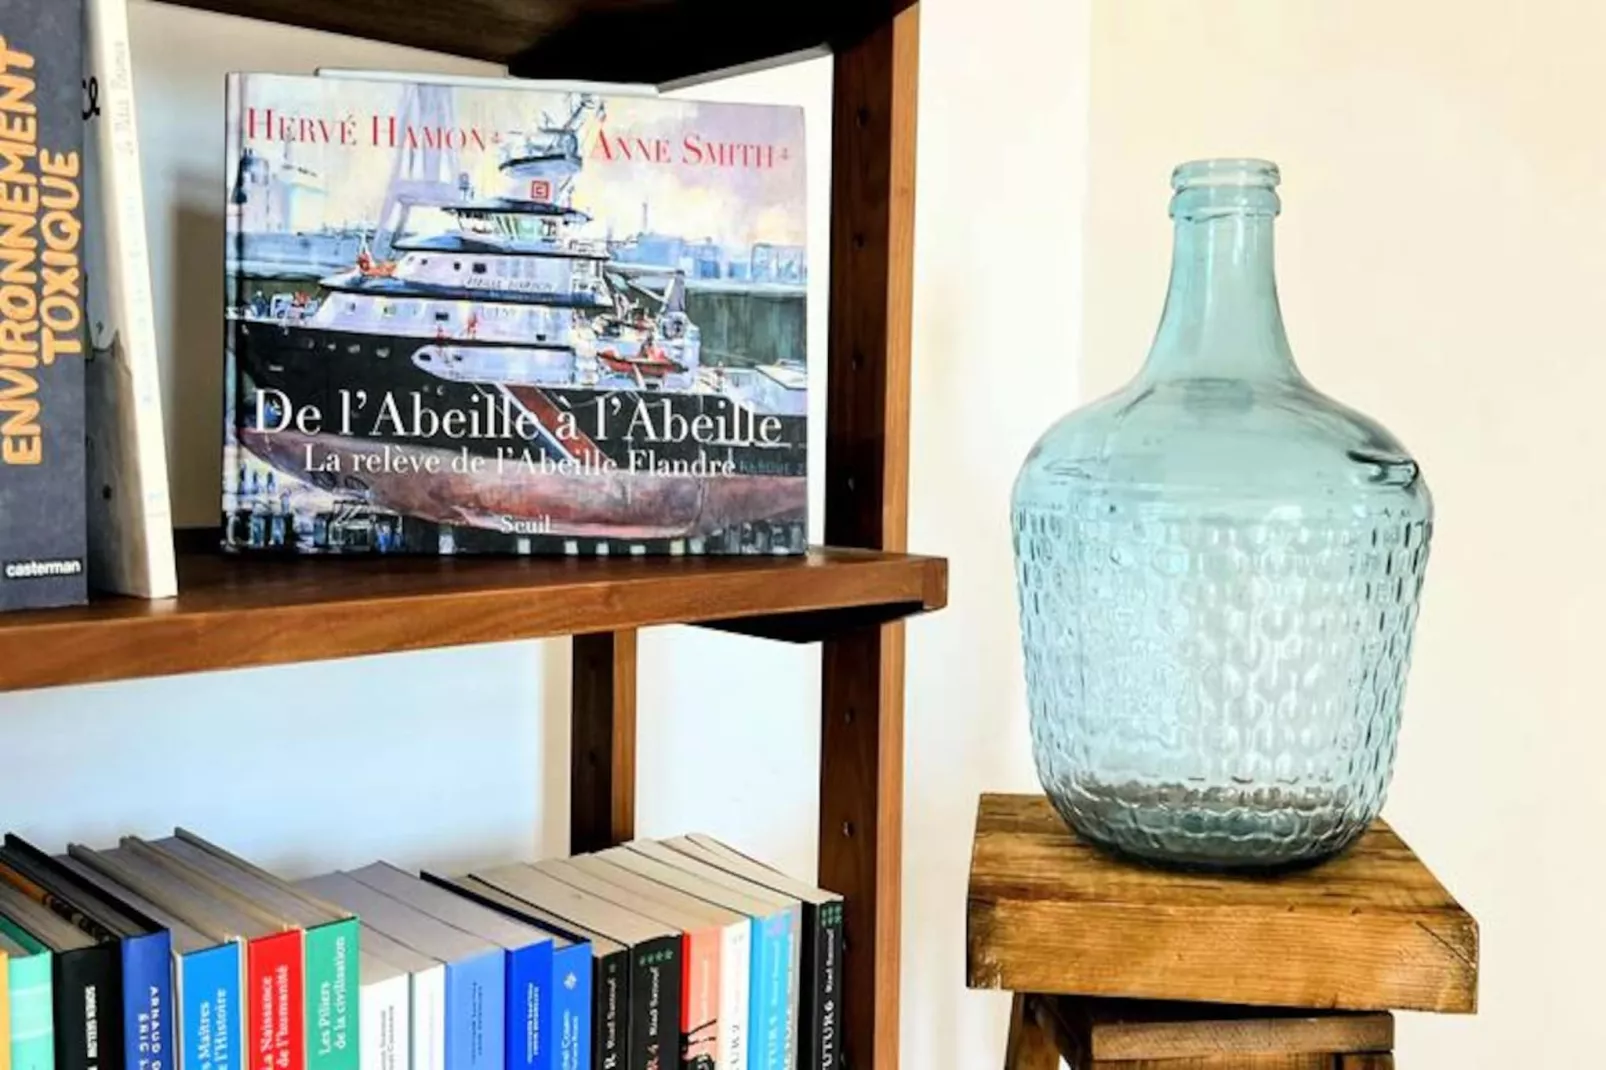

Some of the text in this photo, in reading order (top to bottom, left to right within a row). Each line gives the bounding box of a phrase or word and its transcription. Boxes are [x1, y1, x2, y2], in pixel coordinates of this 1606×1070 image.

[247, 107, 486, 152] HERVÉ HAMON
[592, 127, 775, 168] ANNE SMITH
[0, 34, 43, 466] ENVIRONNEMENT
[41, 148, 81, 366] TOXIQUE
[254, 388, 784, 445] De l'Abeille à l'Abeille
[304, 444, 341, 474] La
[352, 445, 441, 475] relève
[450, 445, 485, 475] de
[496, 445, 617, 477] l'Abeille
[628, 449, 737, 478] Flandre
[499, 513, 552, 535] Seuil
[5, 558, 82, 577] casterman
[150, 985, 161, 1053] ARNAUD
[216, 988, 229, 1062] l'Histoire
[260, 975, 272, 1052] Naissance
[275, 965, 289, 1067] de l'humanité
[318, 981, 332, 1055] Les Piliers
[333, 936, 347, 1049] de la civilisation
[198, 1000, 212, 1059] Maîtres
